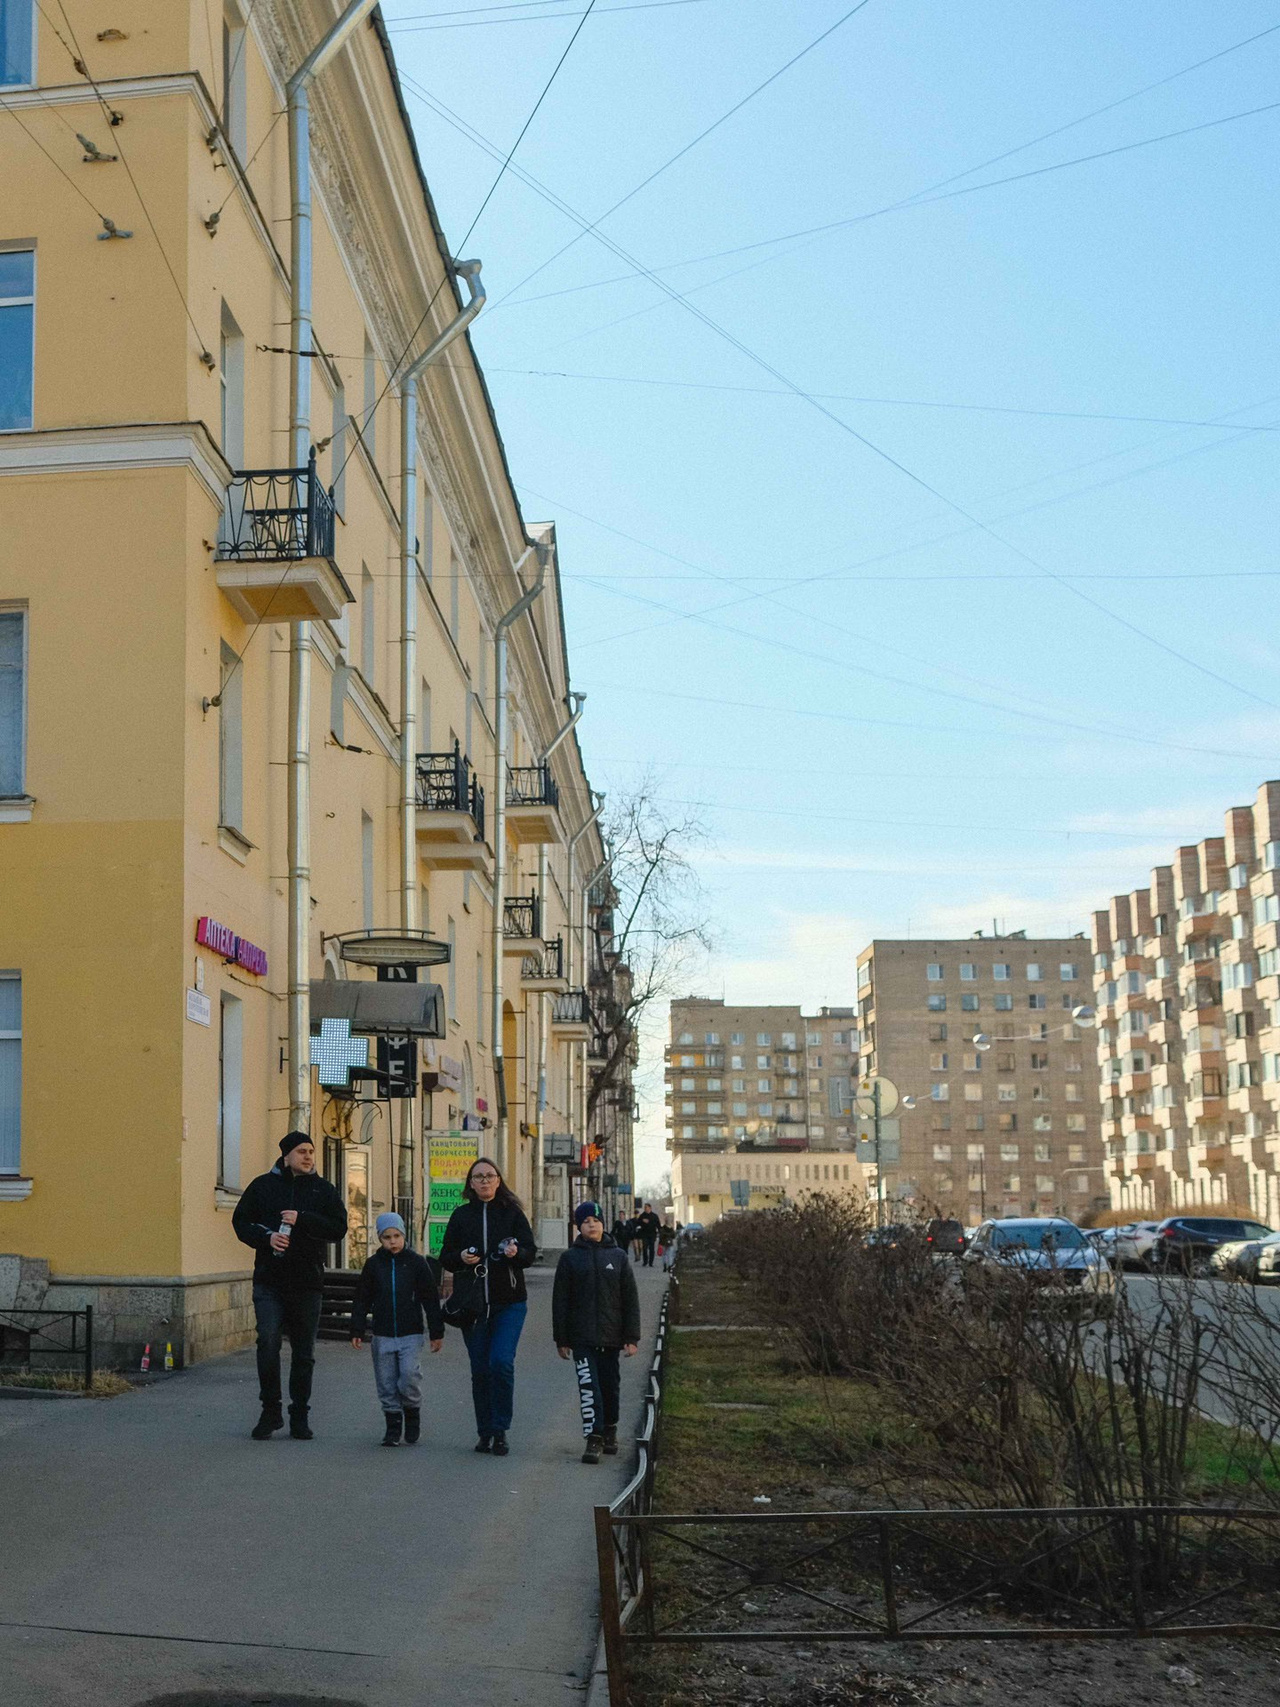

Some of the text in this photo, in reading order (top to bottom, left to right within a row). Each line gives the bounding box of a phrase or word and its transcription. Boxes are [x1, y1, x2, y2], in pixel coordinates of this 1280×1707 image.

[205, 917, 236, 959] АПТЕКА
[430, 1188, 462, 1198] ЖЕНС
[576, 1357, 596, 1437] LLOW ME
